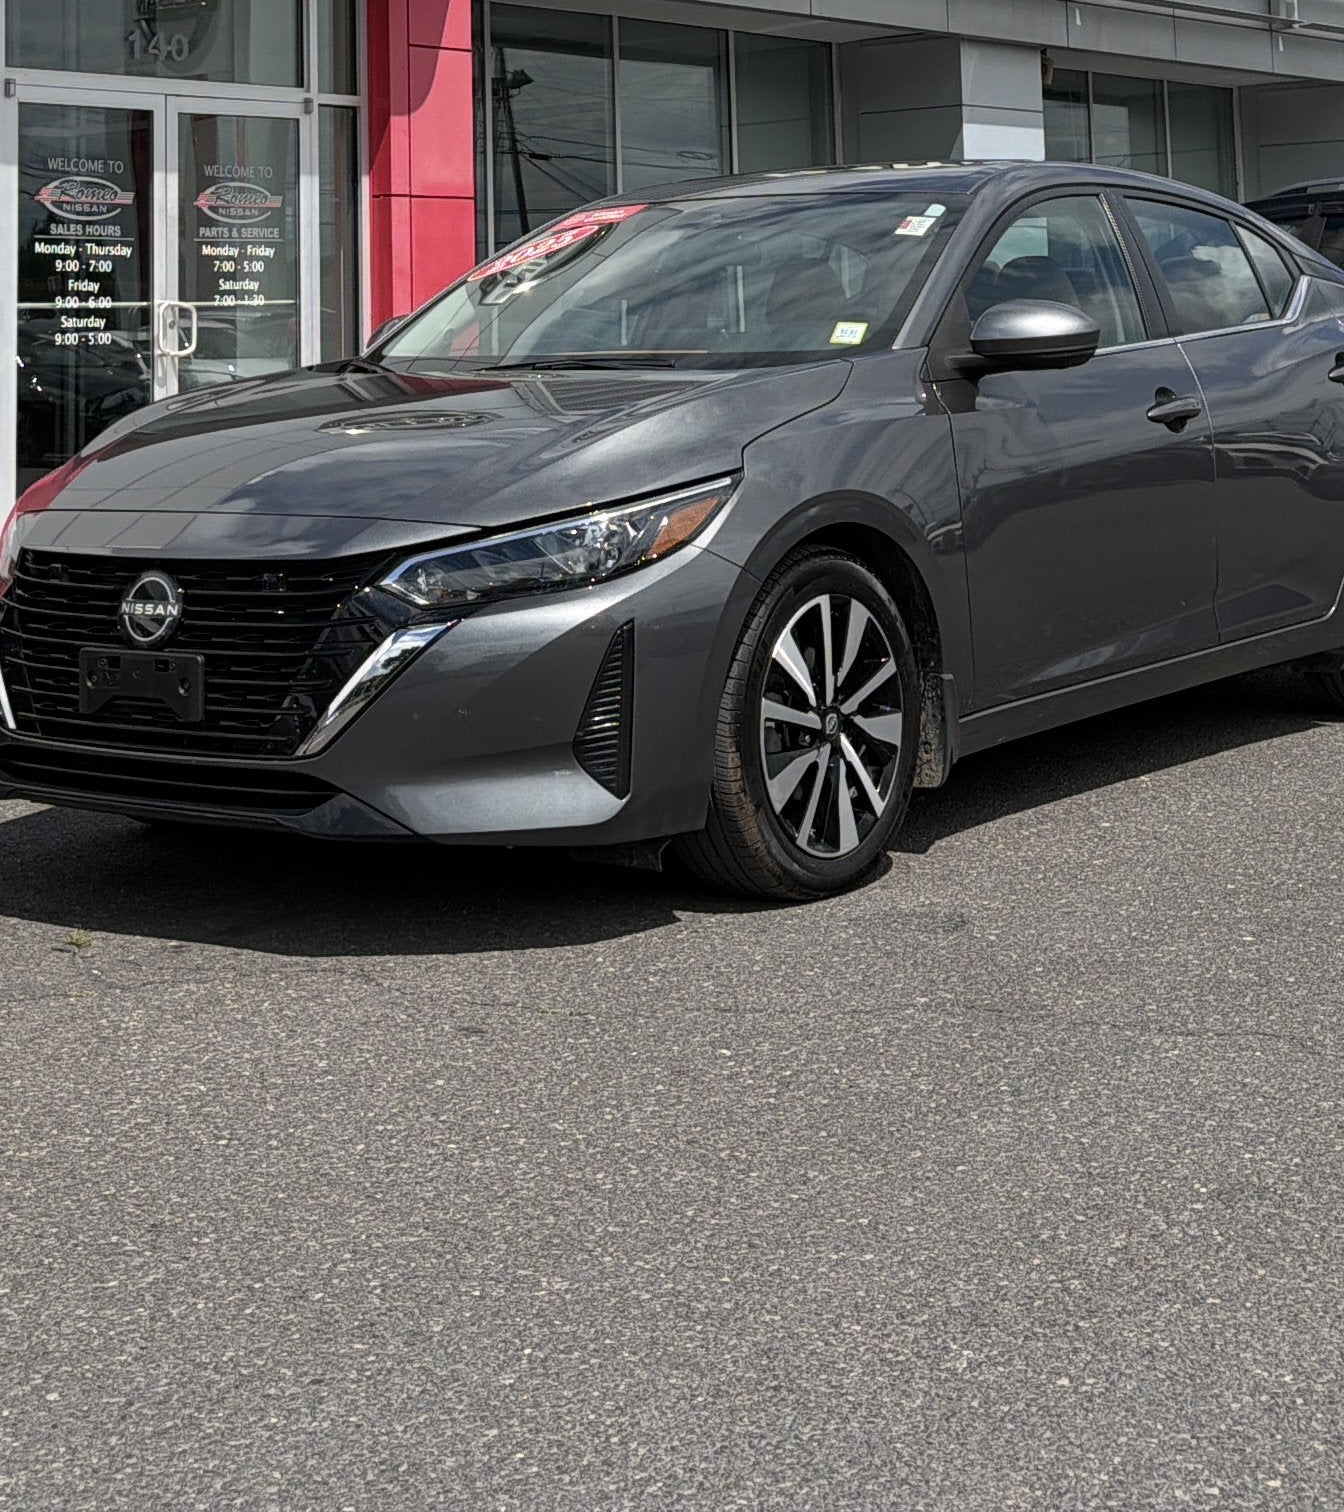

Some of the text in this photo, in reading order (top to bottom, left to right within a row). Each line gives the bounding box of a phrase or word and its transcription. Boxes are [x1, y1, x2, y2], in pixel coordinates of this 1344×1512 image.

[128, 29, 189, 61] 140
[47, 157, 124, 174] WELCOME TO
[203, 164, 273, 179] WELCOME TO
[53, 179, 118, 202] Romeo
[209, 185, 269, 205] Romeo
[62, 203, 107, 213] NISSAN
[218, 208, 259, 216] NISSAN
[49, 223, 122, 237] SALES HOURS
[199, 226, 280, 238] PARTS & SERVICE
[35, 242, 77, 257] Monday
[85, 242, 133, 258] Thursday
[201, 243, 239, 258] Monday
[246, 244, 276, 259] Friday
[55, 259, 80, 272] 9:00
[89, 260, 113, 272] 7:00
[213, 260, 236, 273] 7:00
[243, 260, 265, 273] 5:00
[68, 279, 101, 294] Friday
[218, 278, 260, 292] Saturday
[55, 296, 80, 308] 9:00
[88, 296, 113, 308] 6:00
[213, 294, 236, 306] 7:00
[60, 315, 107, 330] Saturday
[54, 333, 79, 345] 9:00
[88, 333, 112, 345] 5:00
[121, 601, 178, 616] NISSAN
